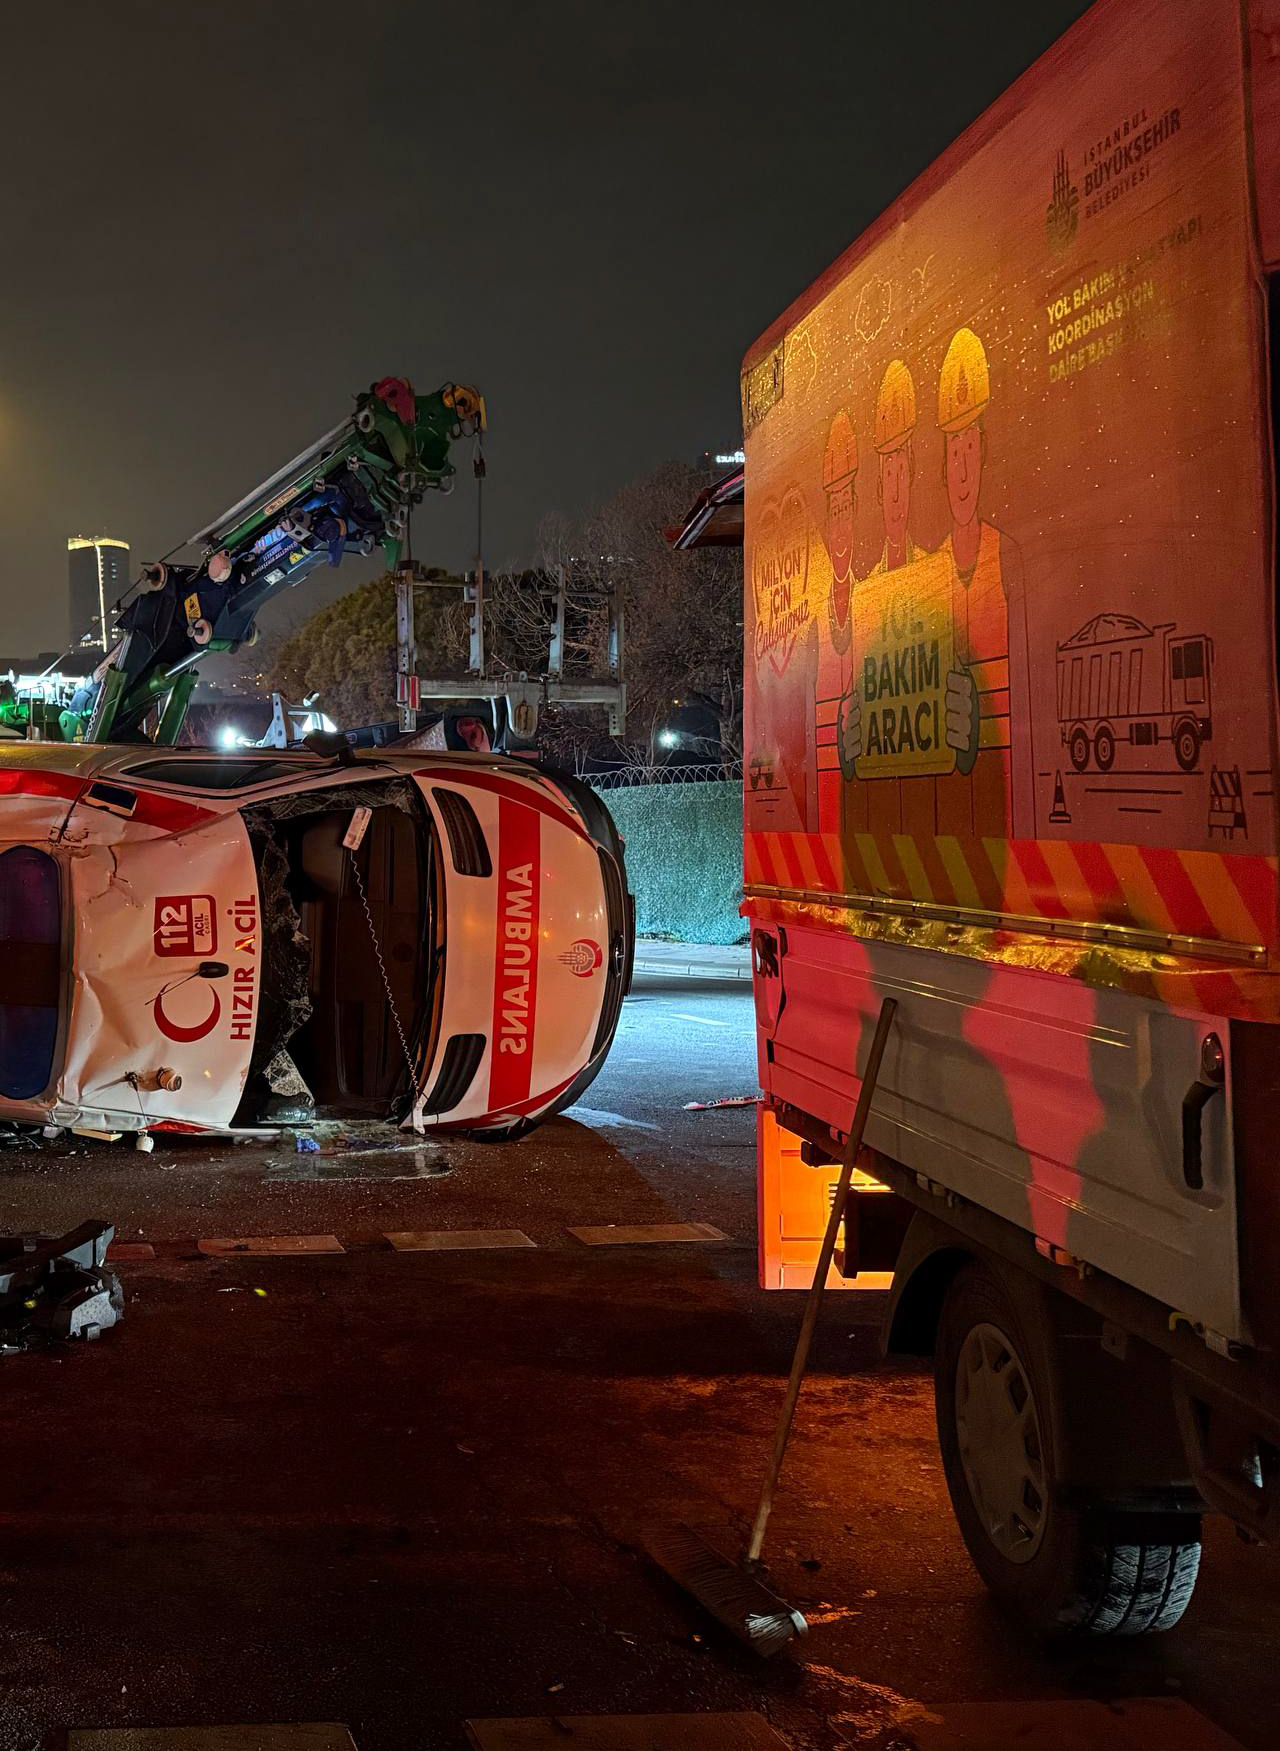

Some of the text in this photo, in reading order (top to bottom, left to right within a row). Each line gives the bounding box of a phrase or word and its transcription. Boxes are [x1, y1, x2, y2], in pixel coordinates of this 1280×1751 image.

[1046, 291, 1072, 325] YOL
[1048, 280, 1155, 355] KOORDİNASYON
[863, 640, 941, 703] BAKIM
[866, 700, 941, 757] ARACI
[160, 904, 189, 949] 112
[226, 894, 257, 1041] HIZIR ACİL
